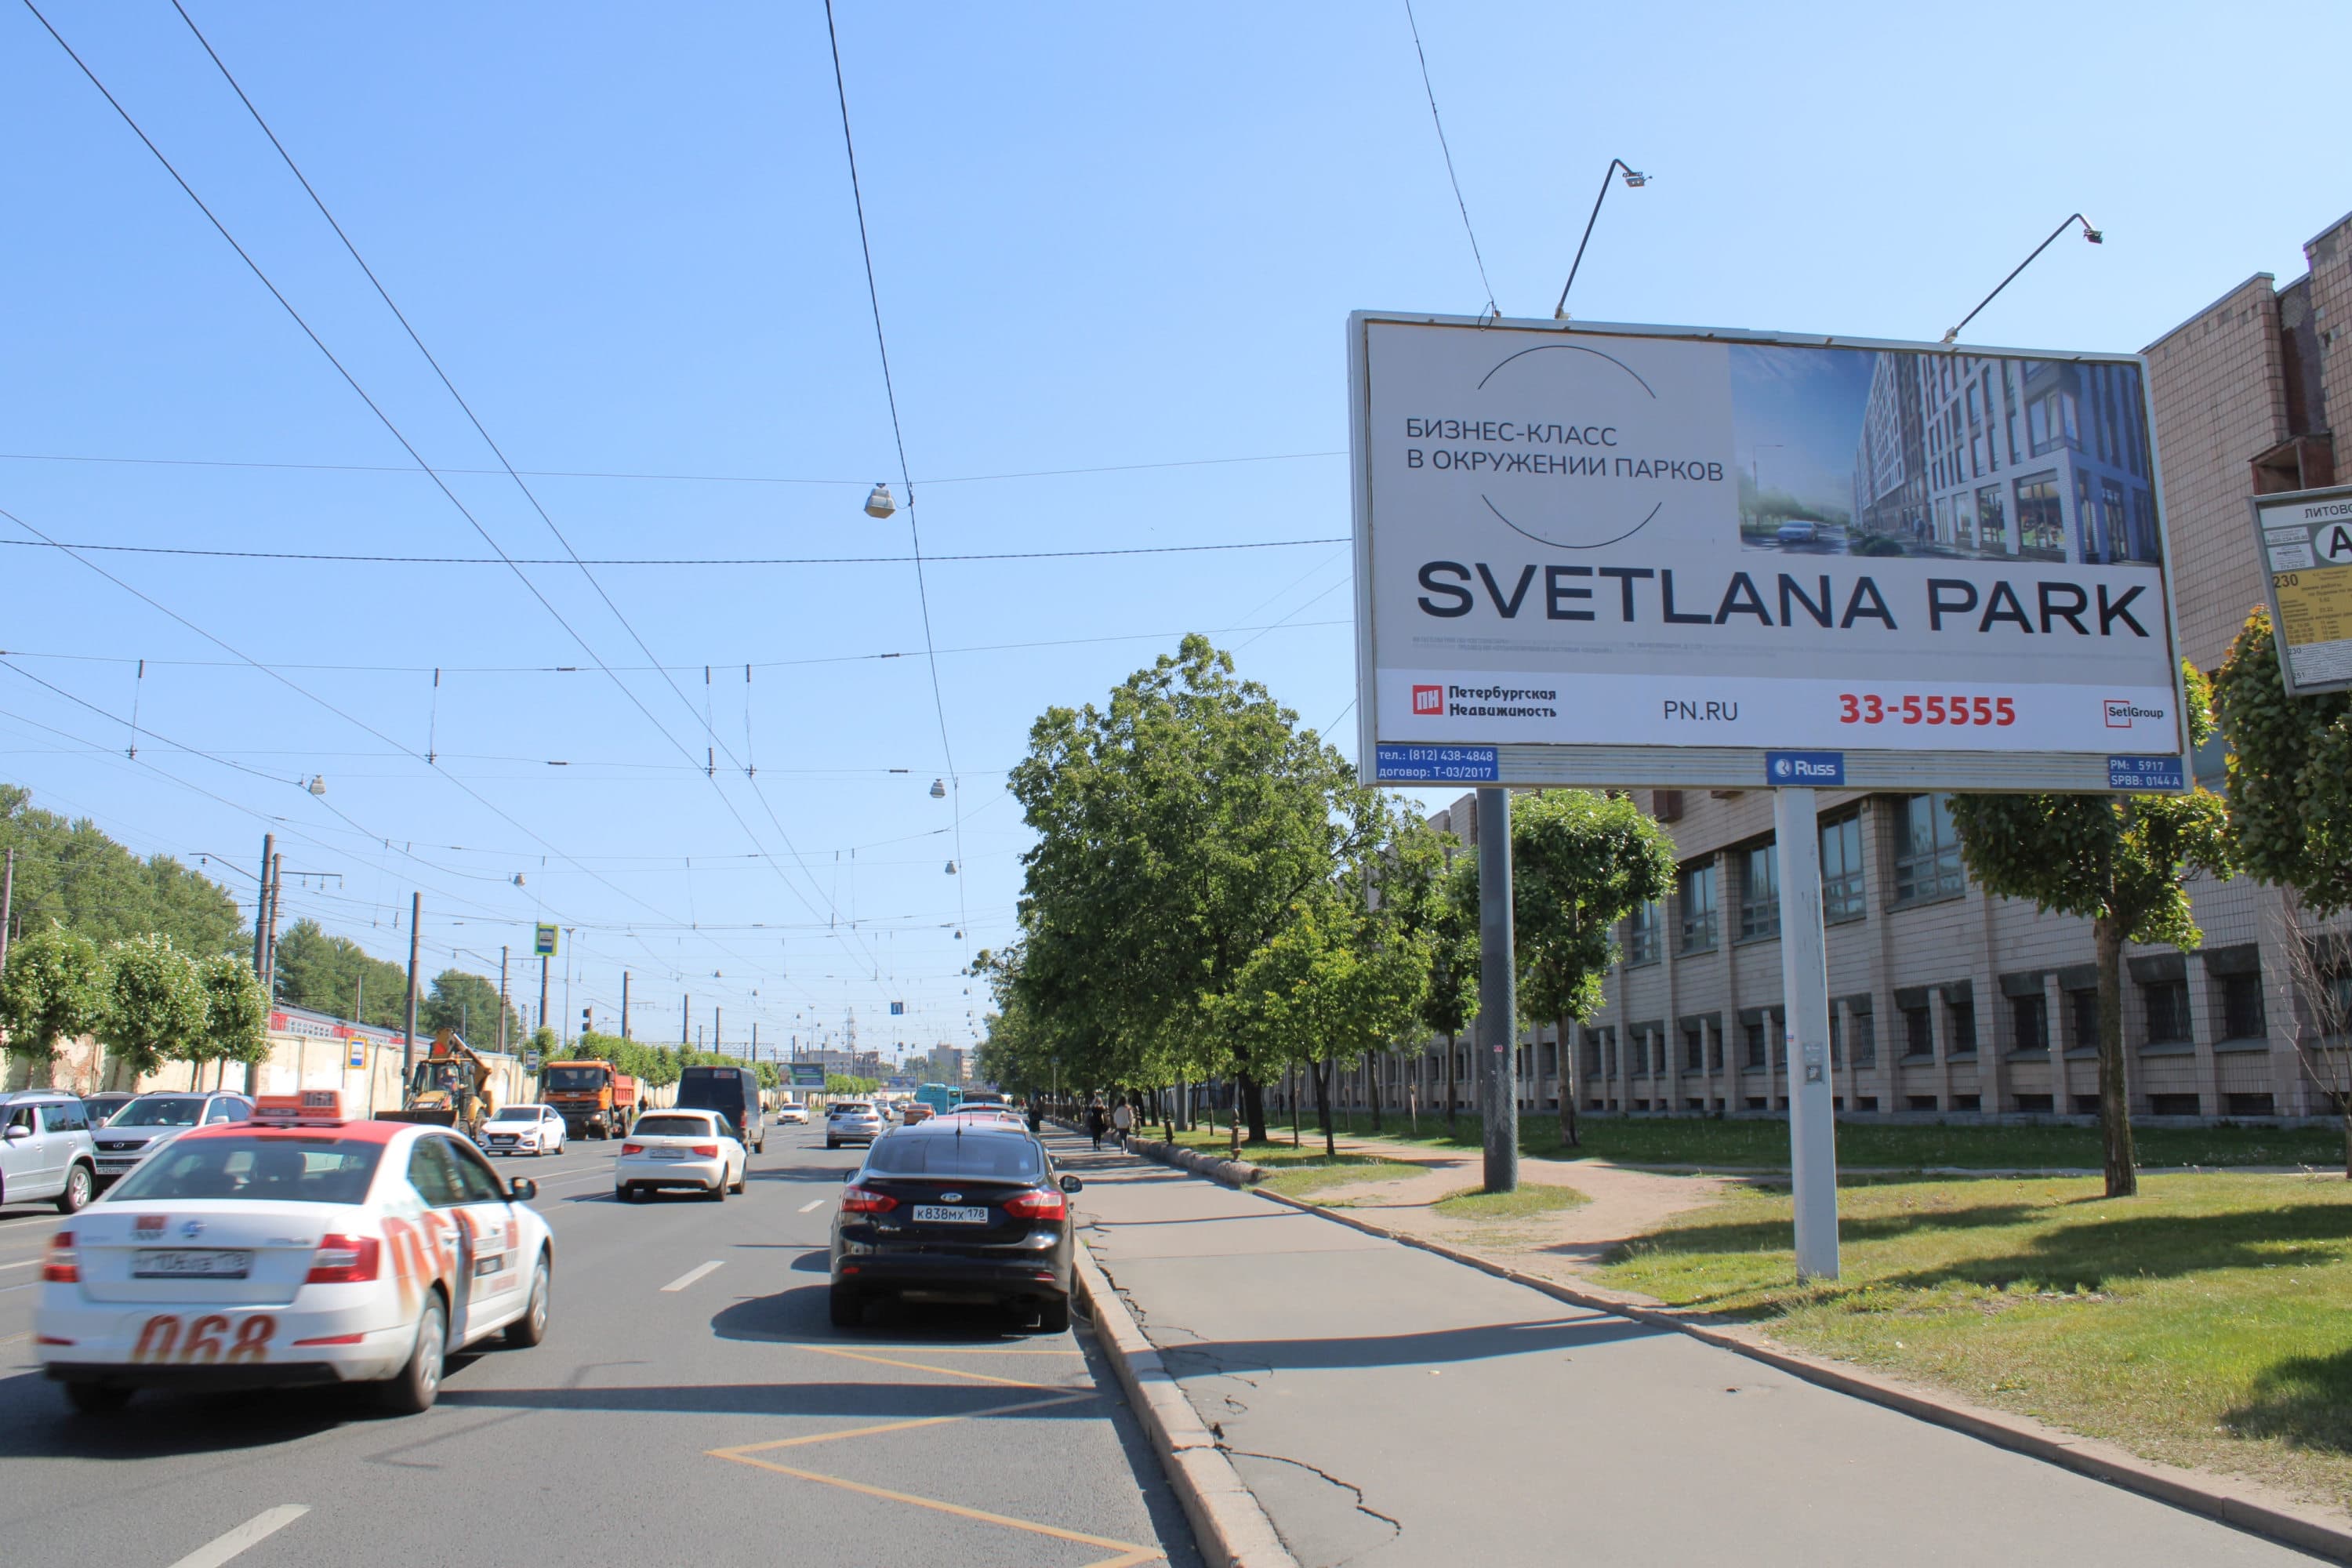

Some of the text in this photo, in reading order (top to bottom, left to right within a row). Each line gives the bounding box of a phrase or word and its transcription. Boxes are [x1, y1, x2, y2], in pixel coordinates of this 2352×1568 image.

[1406, 418, 1618, 447] БИЗНЕС-КЛАСС
[1407, 449, 1724, 482] В ОКРУЖЕНИИ ПАРКОВ
[2273, 574, 2299, 589] 230
[1417, 561, 2151, 637] SVETLANA PARK
[1449, 686, 1556, 701] Петербургская
[1450, 703, 1557, 717] Недвижимость
[1664, 700, 1737, 721] PN.RU
[1839, 694, 2016, 726] 33-55555
[1379, 750, 1494, 762] тел.: (812) 438-4848
[1378, 766, 1492, 779] договор: Т-03/2017
[1795, 760, 1836, 776] Russ
[2138, 761, 2164, 771] 5917
[2146, 776, 2170, 786] 0144
[967, 1209, 985, 1218] 178
[131, 1314, 278, 1364] 068
